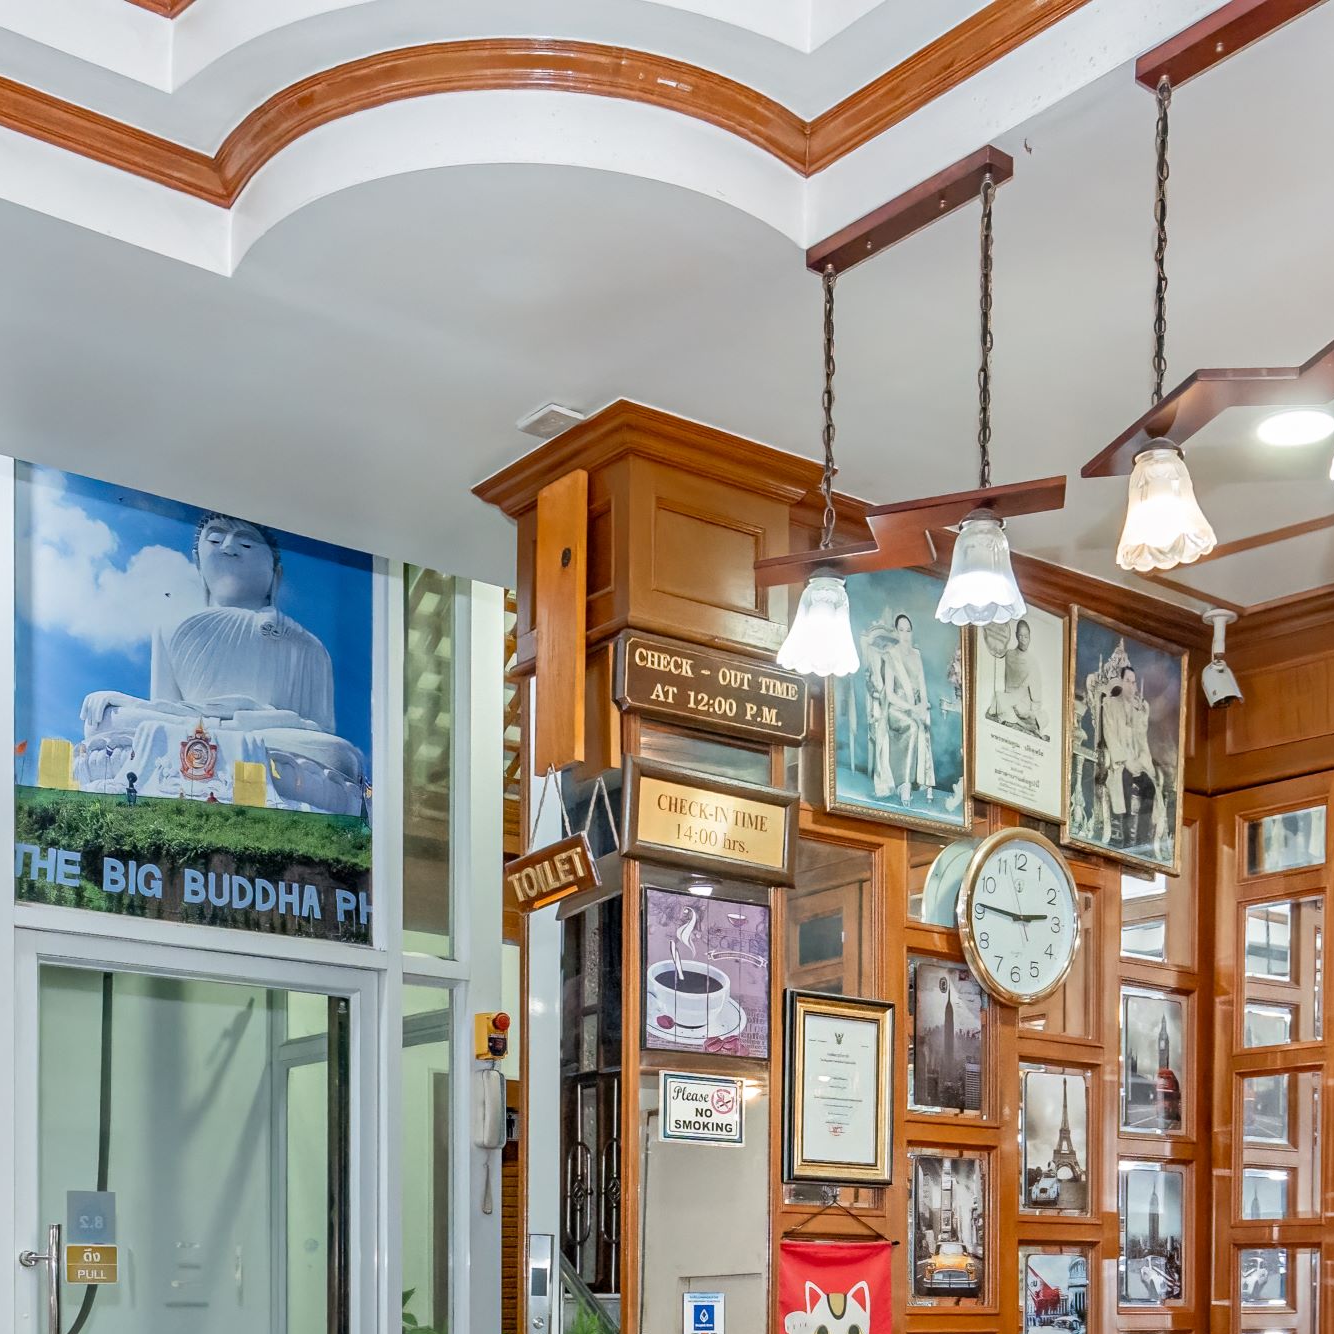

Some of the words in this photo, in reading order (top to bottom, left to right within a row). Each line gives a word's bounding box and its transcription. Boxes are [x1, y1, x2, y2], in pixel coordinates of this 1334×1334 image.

[634, 647, 694, 678] CHECK
[718, 667, 752, 690] OUT
[758, 676, 799, 701] TIME
[650, 683, 678, 703] AT
[687, 691, 737, 717] 12:00
[745, 702, 783, 727] P.M.
[657, 793, 729, 824] CHECK-IN
[733, 809, 768, 832] TIME
[676, 823, 718, 846] 14:00
[722, 832, 749, 853] hrs.
[998, 857, 1008, 876] 11
[1014, 853, 1028, 872] 12
[15, 842, 82, 887] THE
[103, 857, 164, 899] BIG
[183, 868, 322, 920] BUDDHA
[507, 847, 585, 903] TOILET
[1037, 865, 1042, 882] 1
[982, 876, 997, 894] 10
[1046, 888, 1057, 905] 2
[974, 902, 986, 920] 9
[1050, 916, 1061, 933] 3
[979, 931, 990, 949] 8
[1043, 943, 1054, 960] 4
[993, 955, 1004, 973] 7
[1029, 961, 1040, 978] 5
[1010, 966, 1021, 983] 6
[672, 1086, 709, 1103] Please
[695, 1108, 713, 1118] NO
[674, 1119, 733, 1133] SMOKING
[82, 1247, 101, 1262] ดึง
[77, 1269, 107, 1280] PULL
